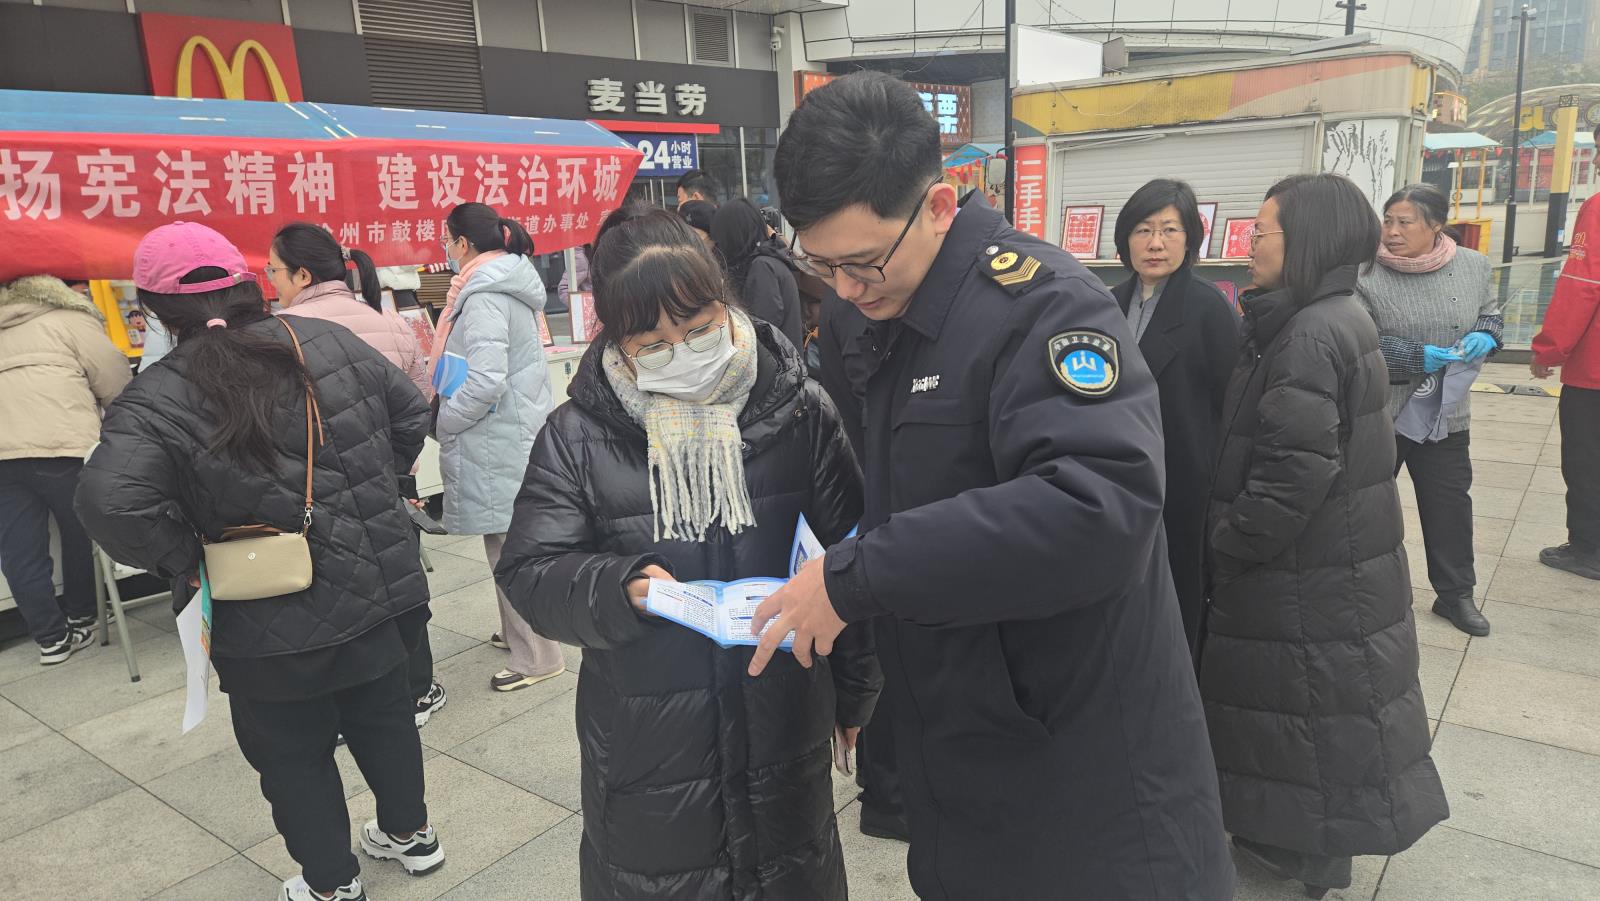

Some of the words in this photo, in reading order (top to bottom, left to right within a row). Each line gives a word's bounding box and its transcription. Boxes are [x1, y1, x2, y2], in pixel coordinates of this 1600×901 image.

[587, 78, 707, 116] 麦当劳
[638, 140, 671, 170] 24
[671, 141, 692, 154] 小时
[671, 155, 693, 169] 营业
[0, 148, 335, 221] 扬宪法精神
[376, 153, 622, 211] 建设法治环城
[1019, 160, 1043, 238] 二手手
[508, 212, 589, 235] 道办事处
